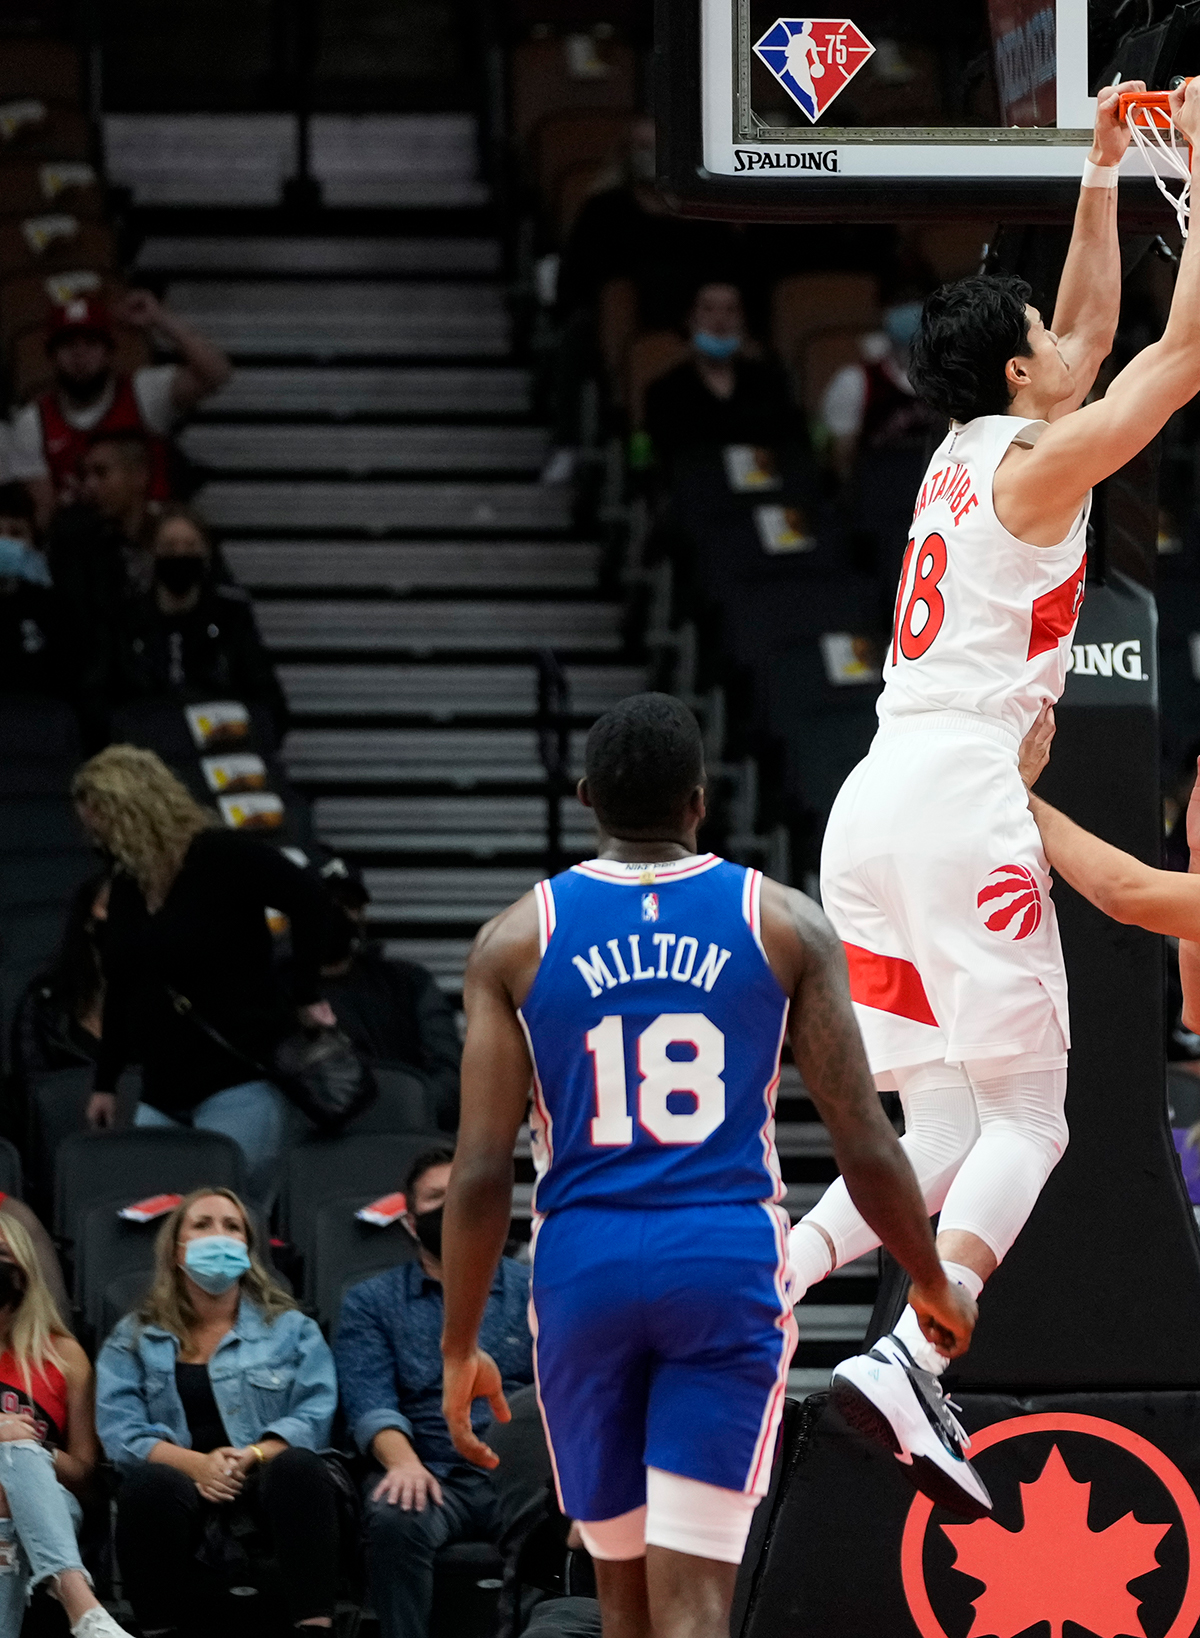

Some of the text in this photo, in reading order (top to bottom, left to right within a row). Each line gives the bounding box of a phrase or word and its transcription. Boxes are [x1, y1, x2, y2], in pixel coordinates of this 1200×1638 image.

[825, 34, 848, 65] 75
[734, 149, 838, 172] SPALDING
[892, 532, 947, 667] 18
[572, 932, 732, 998] MILTON
[585, 1012, 726, 1146] 18
